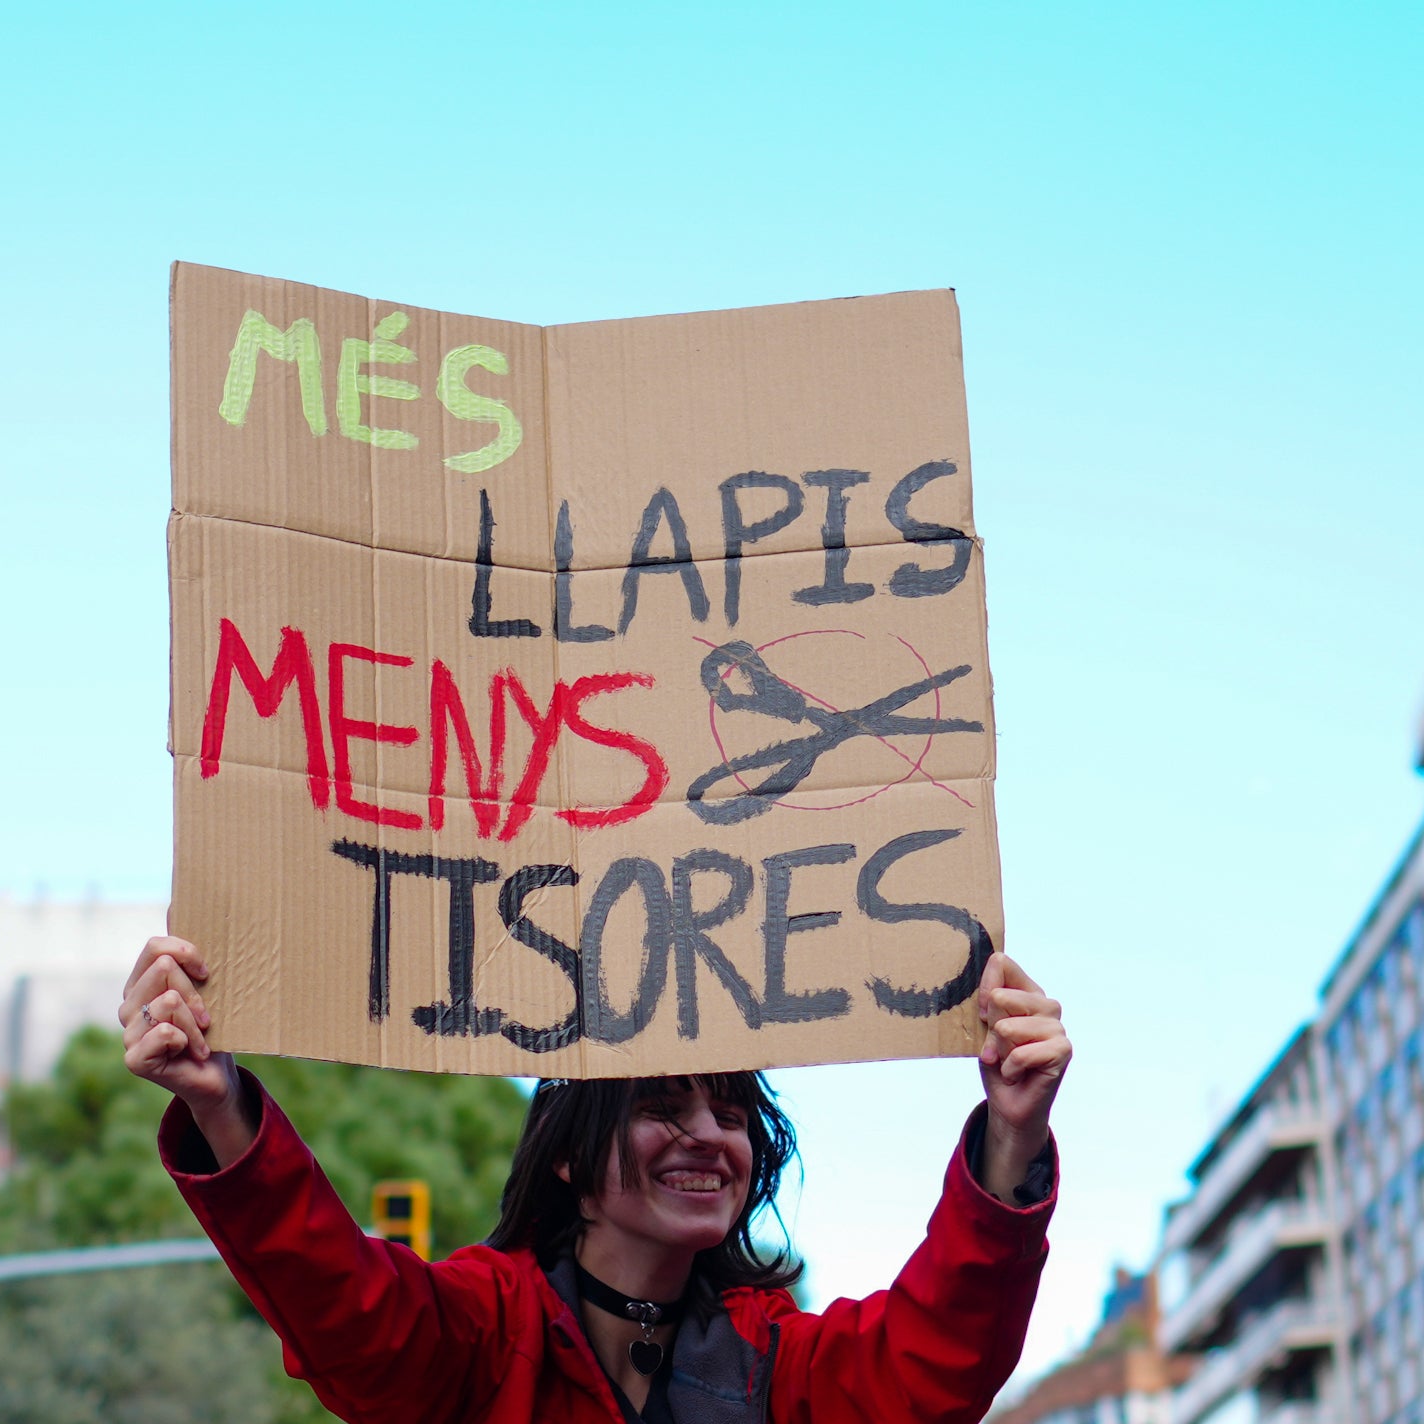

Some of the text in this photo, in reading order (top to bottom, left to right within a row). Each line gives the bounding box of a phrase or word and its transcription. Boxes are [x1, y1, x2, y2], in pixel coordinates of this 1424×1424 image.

[219, 309, 523, 473] MÉS
[468, 458, 973, 643] LLAPIS
[200, 617, 671, 842] MENYS
[330, 828, 994, 1053] TISORES
